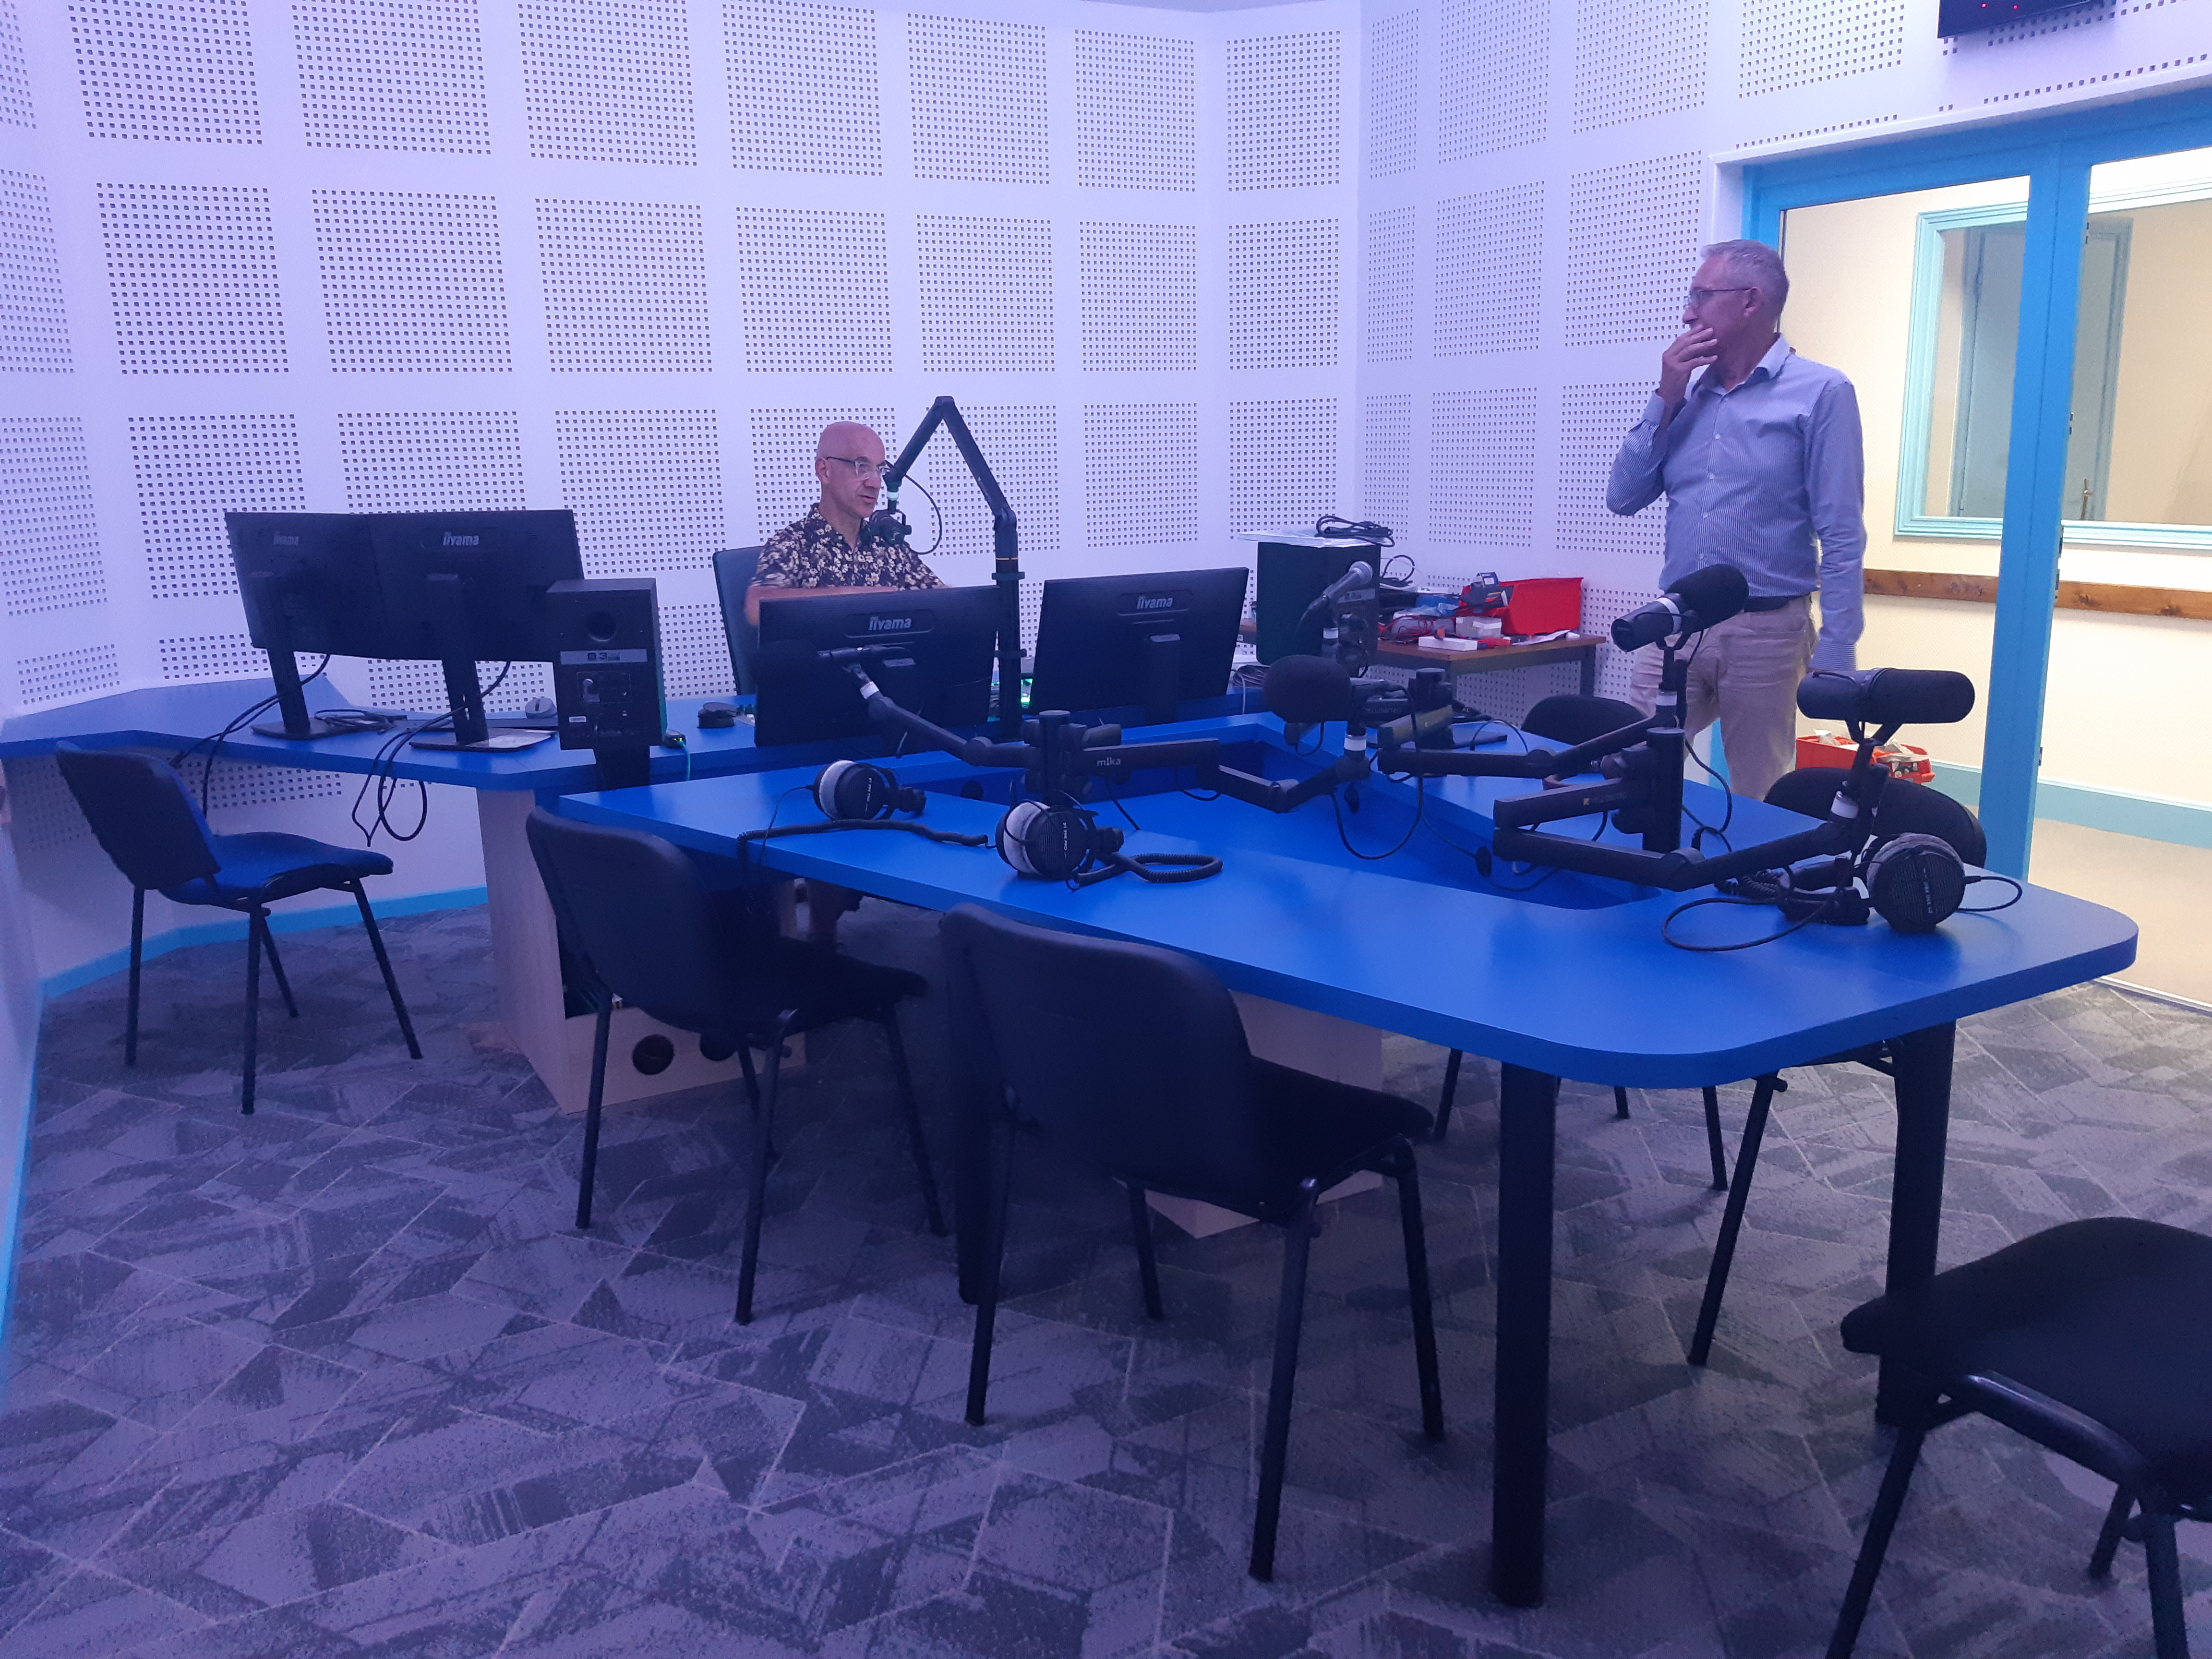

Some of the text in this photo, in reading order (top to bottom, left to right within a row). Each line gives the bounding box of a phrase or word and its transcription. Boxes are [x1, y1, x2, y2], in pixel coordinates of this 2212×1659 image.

[443, 531, 479, 545] iiyama
[1137, 596, 1173, 609] iiyama
[868, 616, 912, 630] iiyama
